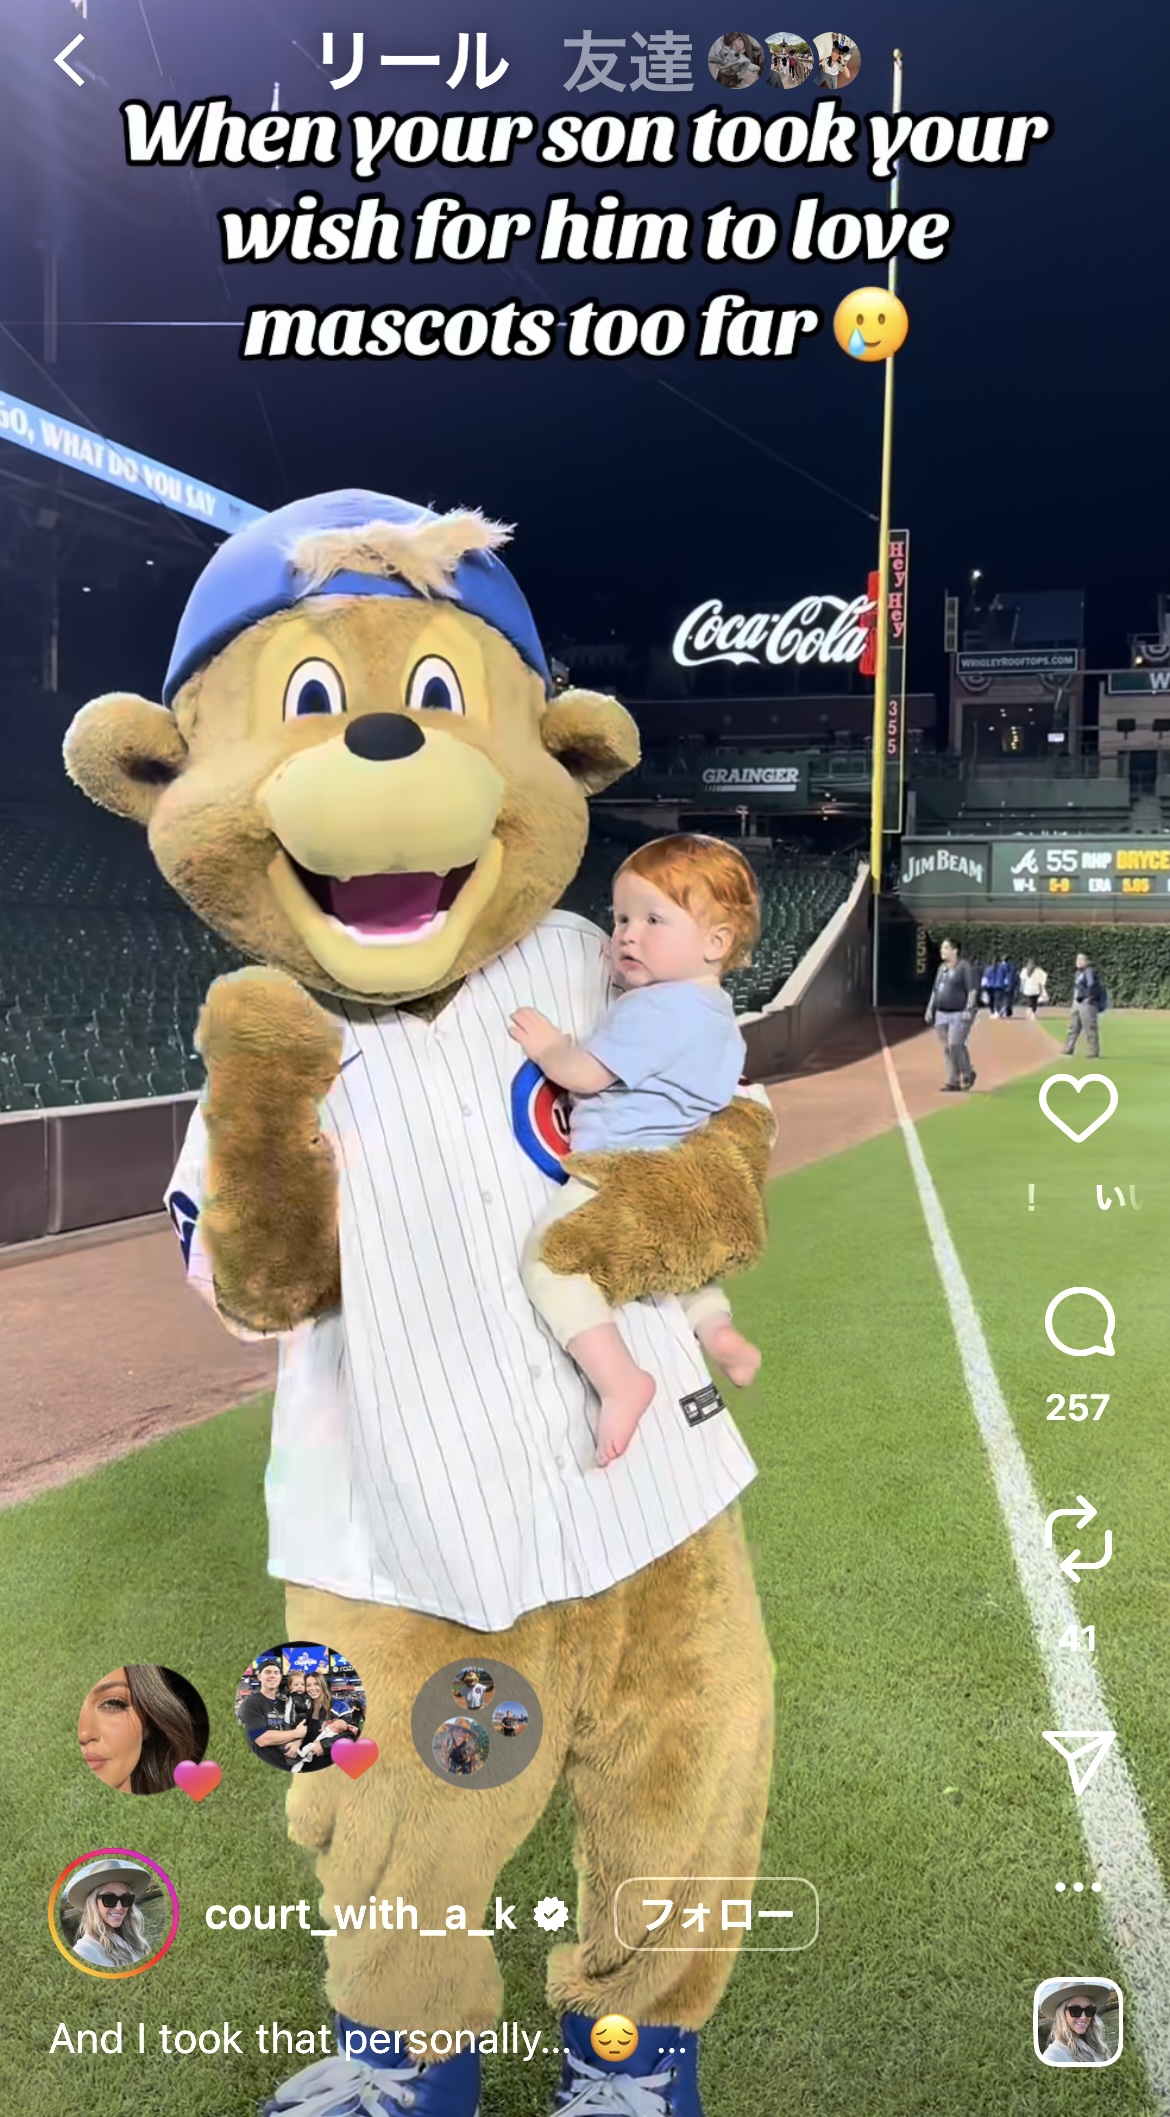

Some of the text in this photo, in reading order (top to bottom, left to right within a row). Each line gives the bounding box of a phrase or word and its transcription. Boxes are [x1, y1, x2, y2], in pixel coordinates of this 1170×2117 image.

[39, 417, 105, 469] WHAT
[109, 454, 137, 483] DO
[142, 463, 182, 499] YOU
[186, 484, 217, 517] SAY
[888, 541, 906, 638] Hey Hey
[672, 594, 878, 668] Coca-Cola
[961, 656, 1074, 668] WRIGLEYROOFTOPS.COM
[887, 701, 898, 755] 355
[702, 768, 799, 783] GRAINGER
[902, 849, 985, 884] JIM BEAM
[1046, 849, 1078, 872] 55
[1081, 851, 1112, 869] RHP
[1012, 878, 1037, 892] W-L
[1088, 878, 1112, 893] ERA
